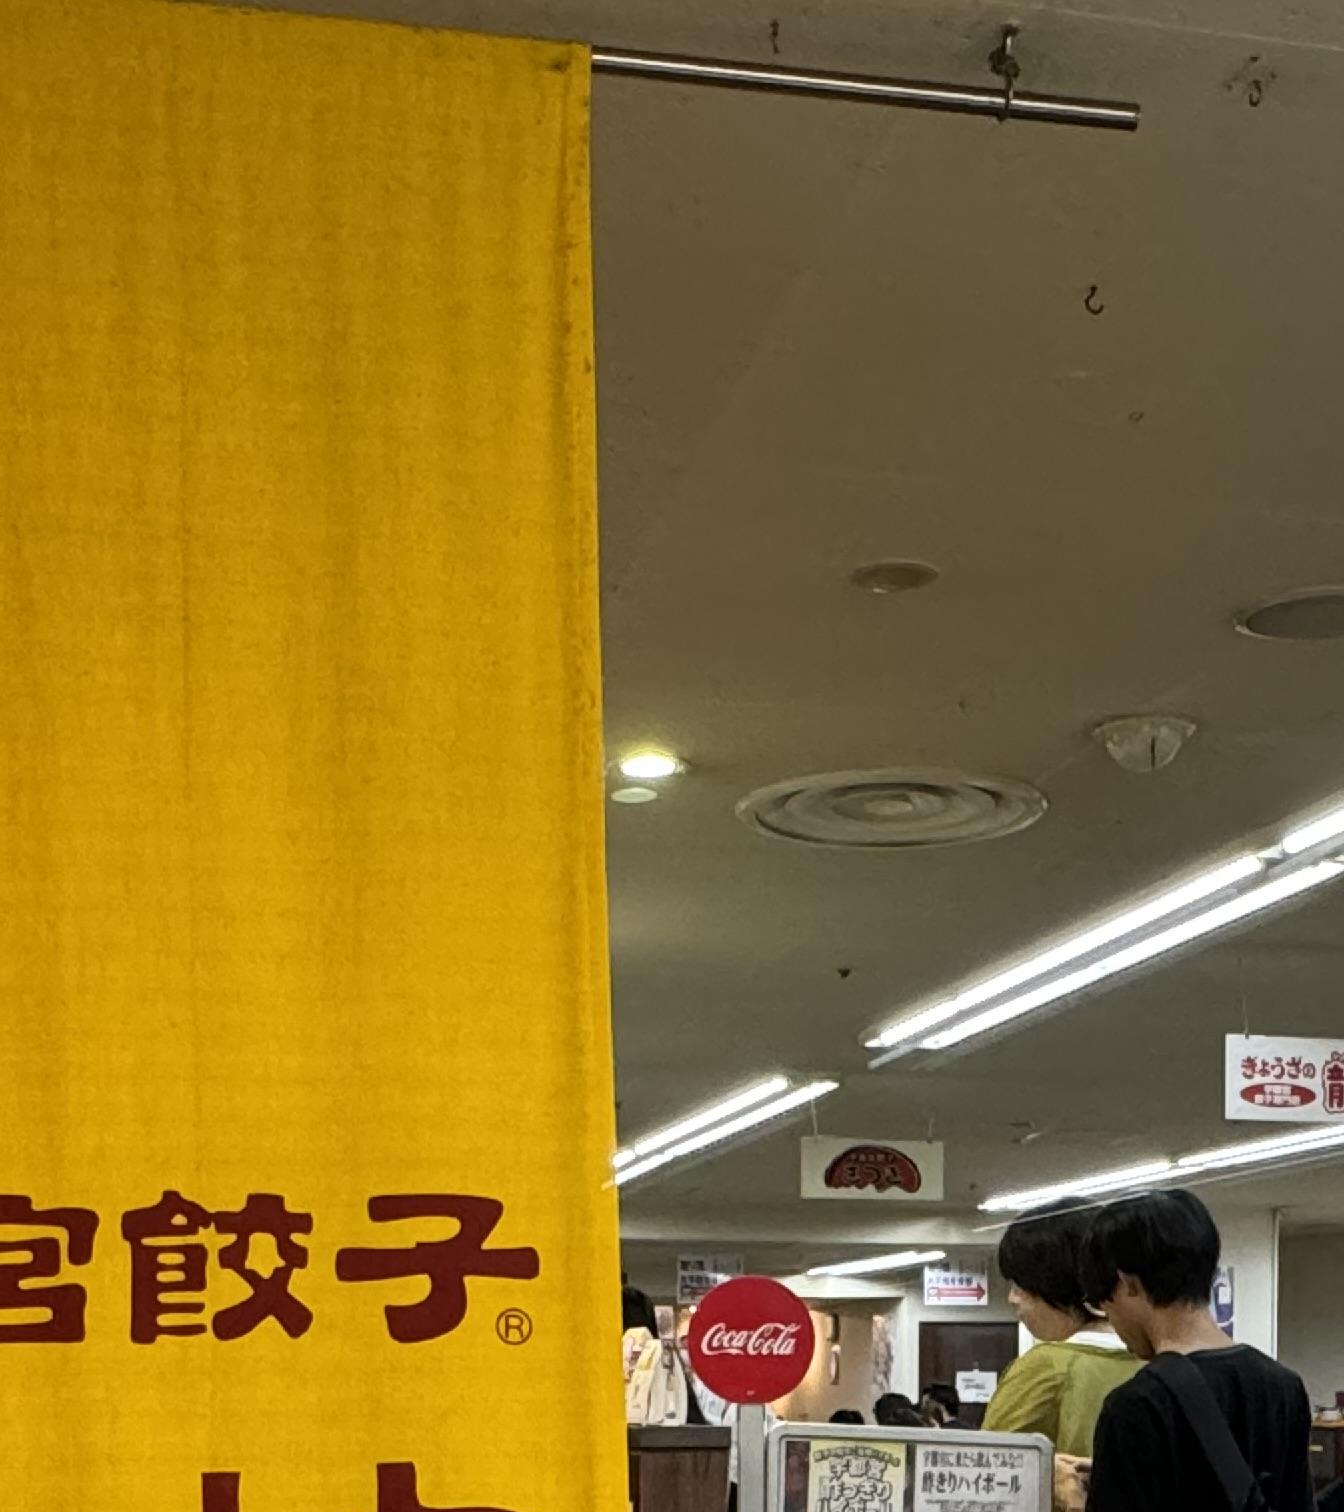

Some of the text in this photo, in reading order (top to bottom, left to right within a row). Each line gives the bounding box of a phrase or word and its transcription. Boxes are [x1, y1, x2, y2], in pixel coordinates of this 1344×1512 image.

[1240, 1055, 1316, 1080] ぎょうざの
[700, 1322, 802, 1356] Coca-Cola
